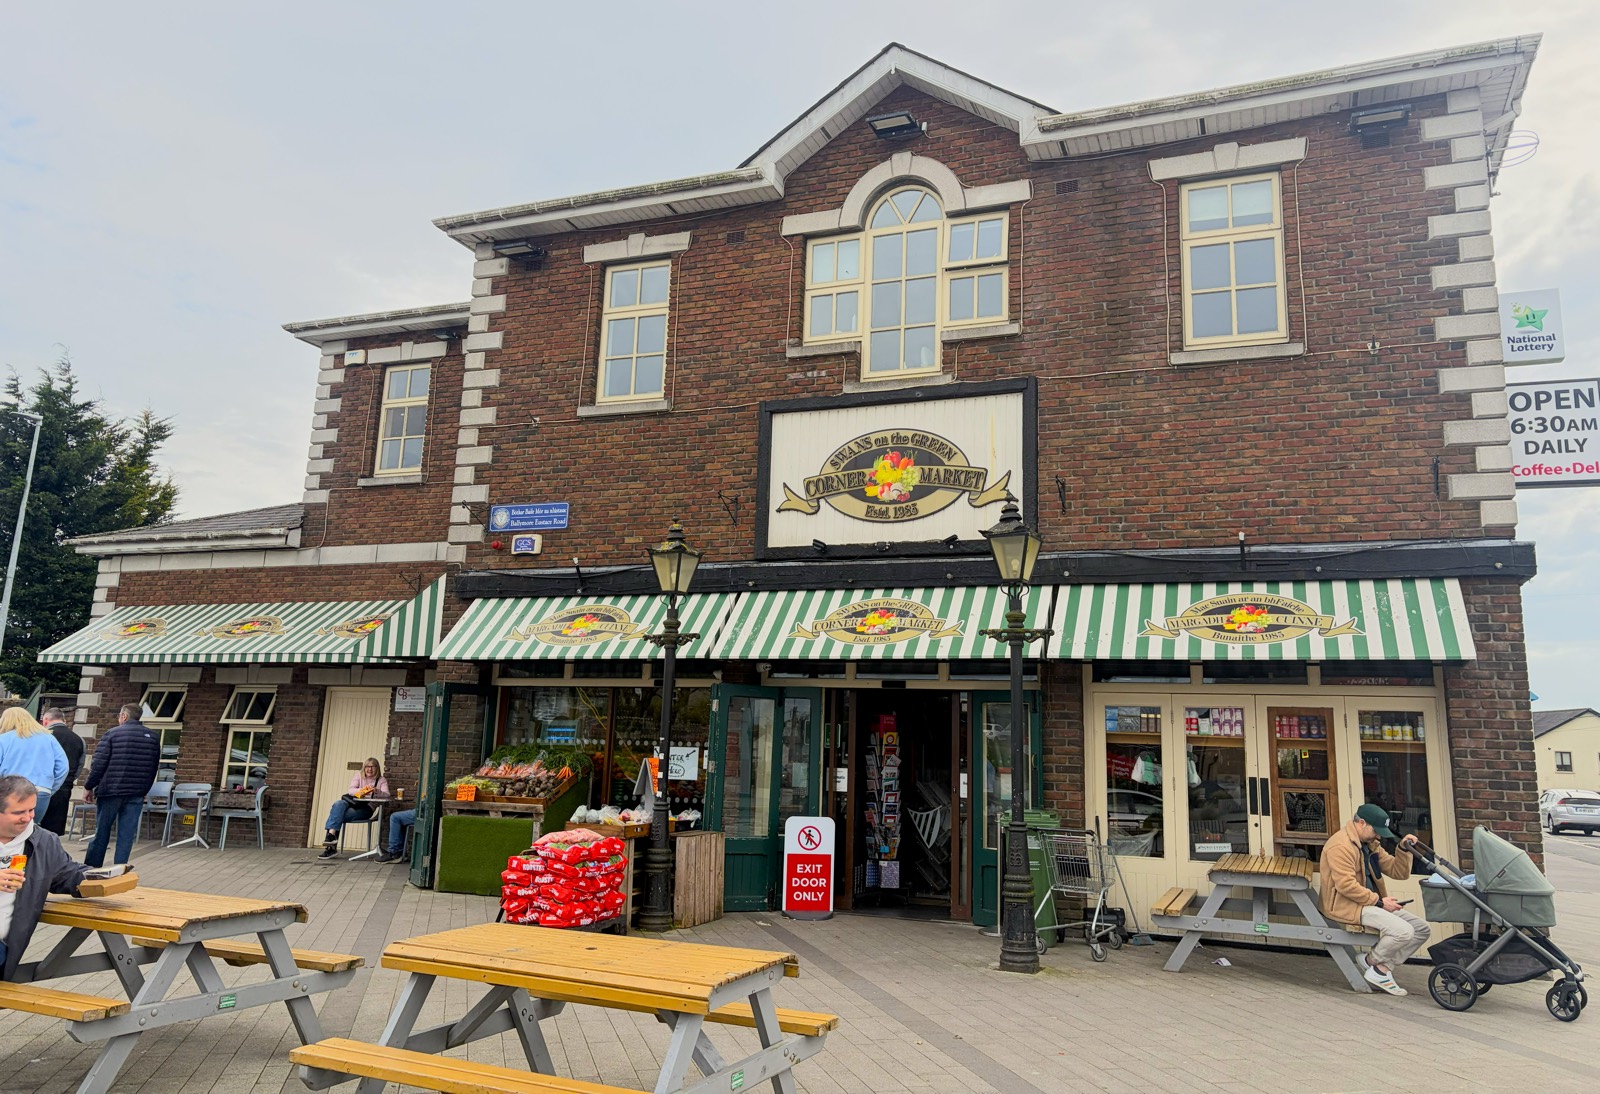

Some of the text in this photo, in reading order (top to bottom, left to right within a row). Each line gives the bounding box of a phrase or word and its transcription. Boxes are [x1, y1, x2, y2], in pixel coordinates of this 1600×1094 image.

[1507, 333, 1556, 343] National
[1511, 343, 1554, 352] Lottery
[1509, 387, 1596, 413] OPEN
[1510, 415, 1598, 435] 6:30AM
[830, 432, 956, 470] SWANS on the GREEN
[1524, 437, 1588, 455] DAILY
[805, 467, 985, 497] CORNER MARKET
[893, 503, 919, 518] 1985
[510, 517, 566, 528] Ballymore Eustace Road
[836, 603, 870, 617] SWANS
[1190, 604, 1209, 615] Mac
[814, 618, 943, 631] CORNER MARKET
[1170, 615, 1323, 629] MARGADH CUINNE
[1211, 631, 1285, 642] Bunaithe 1985
[796, 863, 823, 874] EXIT
[792, 877, 827, 888] DOOR
[793, 891, 825, 901] ONLY
